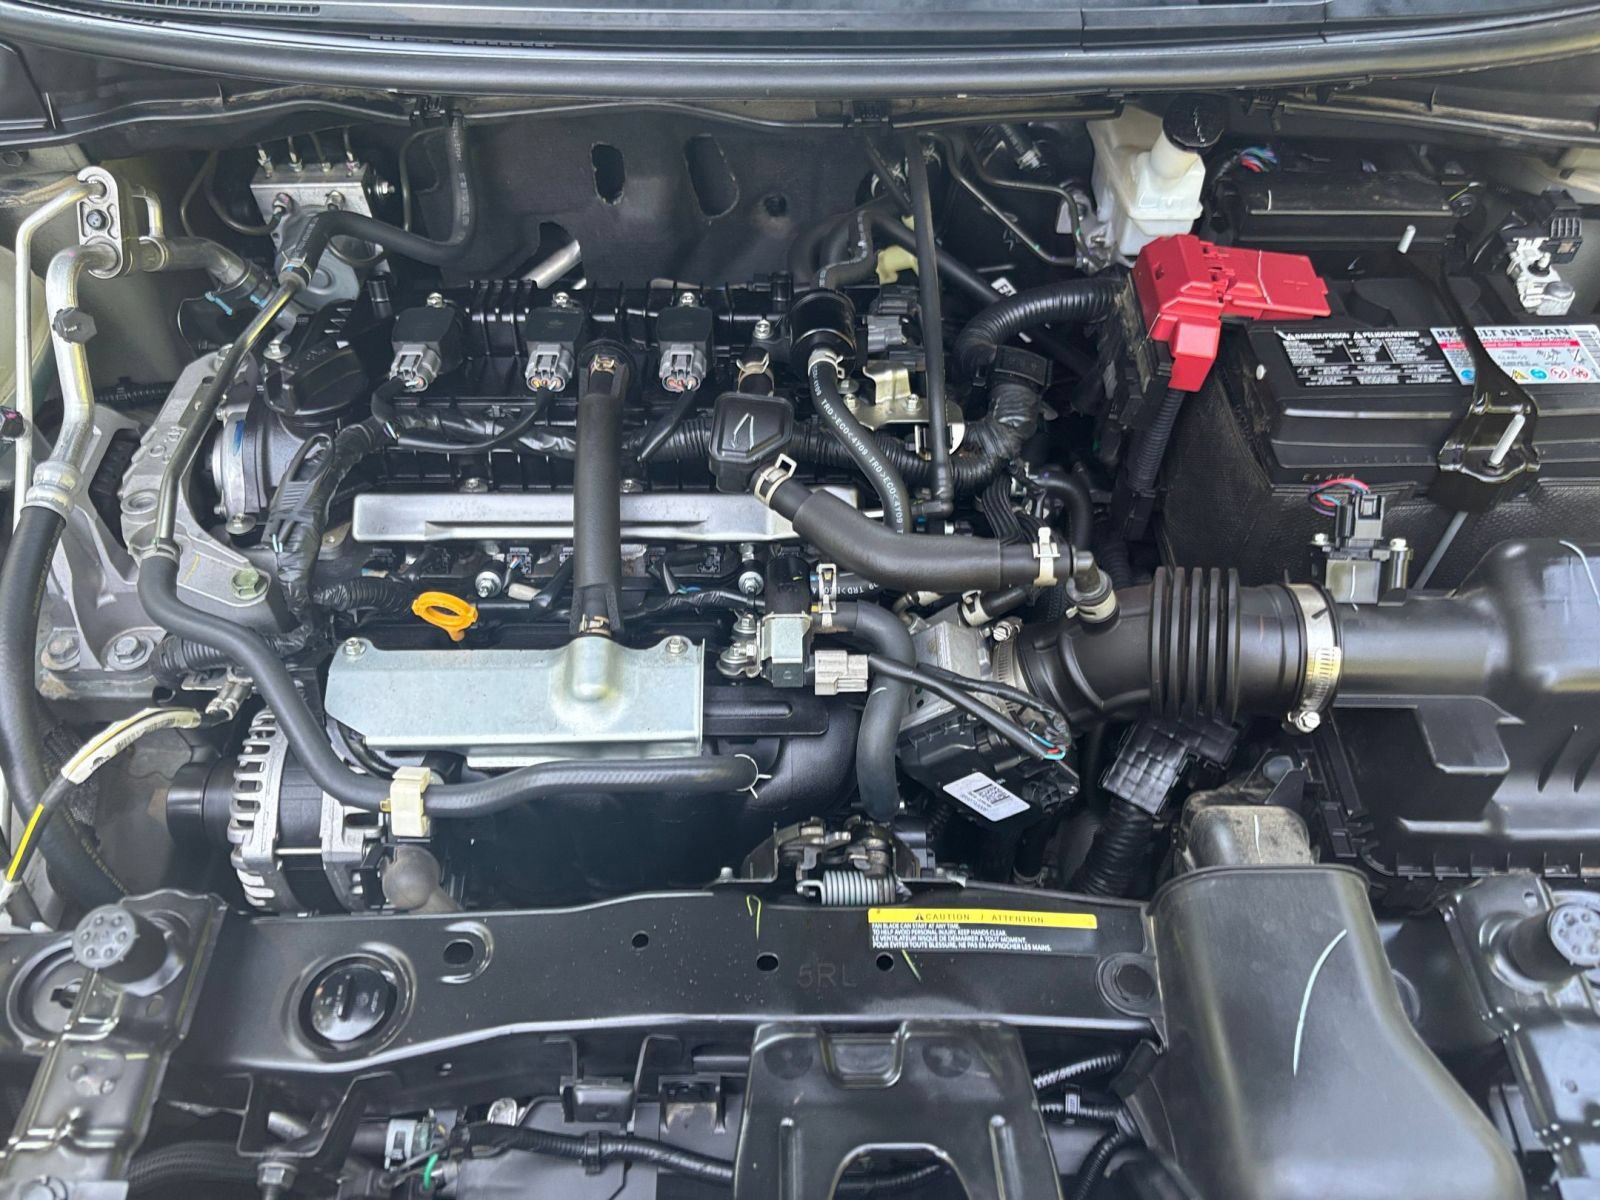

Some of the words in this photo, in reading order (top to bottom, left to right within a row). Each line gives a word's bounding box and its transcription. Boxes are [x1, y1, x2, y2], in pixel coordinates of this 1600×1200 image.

[1502, 328, 1570, 337] NISSAN
[925, 913, 970, 921] CAUTION
[991, 914, 1044, 924] ATTENTION
[872, 941, 889, 949] POUR
[987, 942, 1021, 950] APPROCHER
[1021, 943, 1031, 951] LES
[797, 962, 858, 988] 5RL
